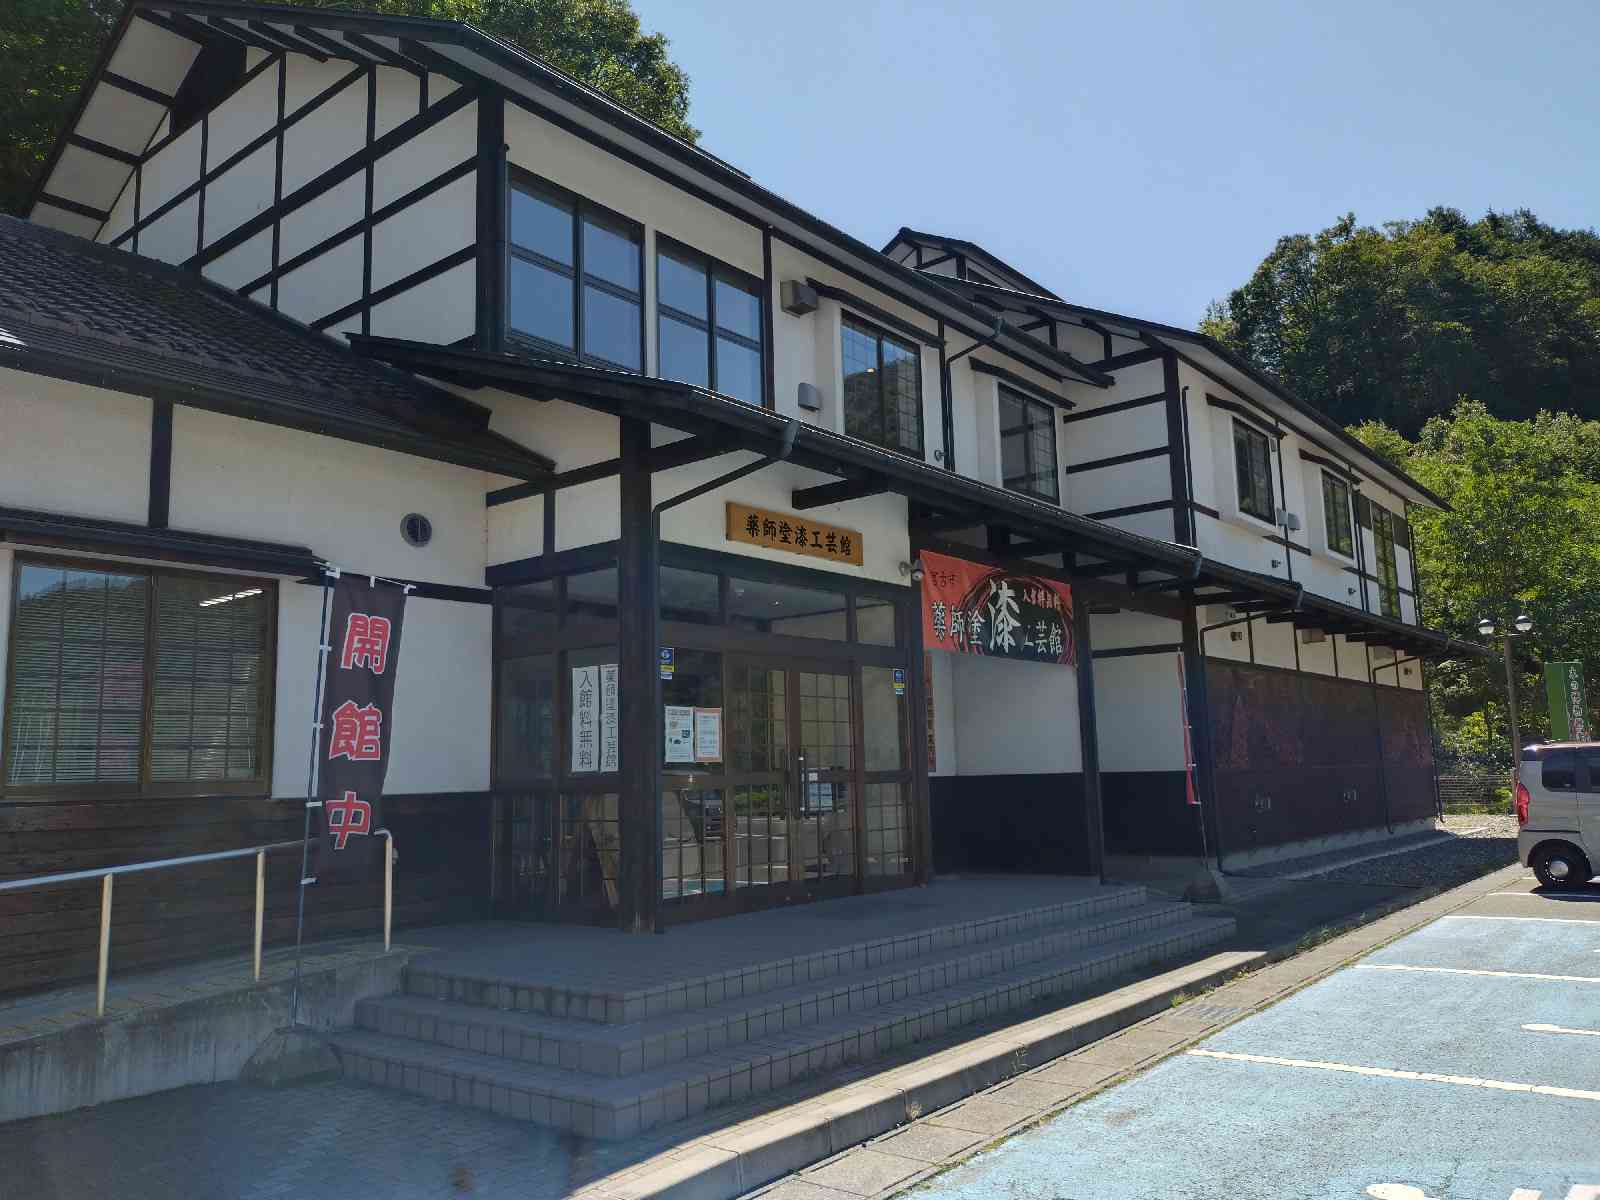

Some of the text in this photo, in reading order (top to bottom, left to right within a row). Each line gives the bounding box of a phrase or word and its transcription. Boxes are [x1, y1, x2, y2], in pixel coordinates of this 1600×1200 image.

[326, 613, 390, 849] 開館中
[577, 670, 593, 769] 入館料無料
